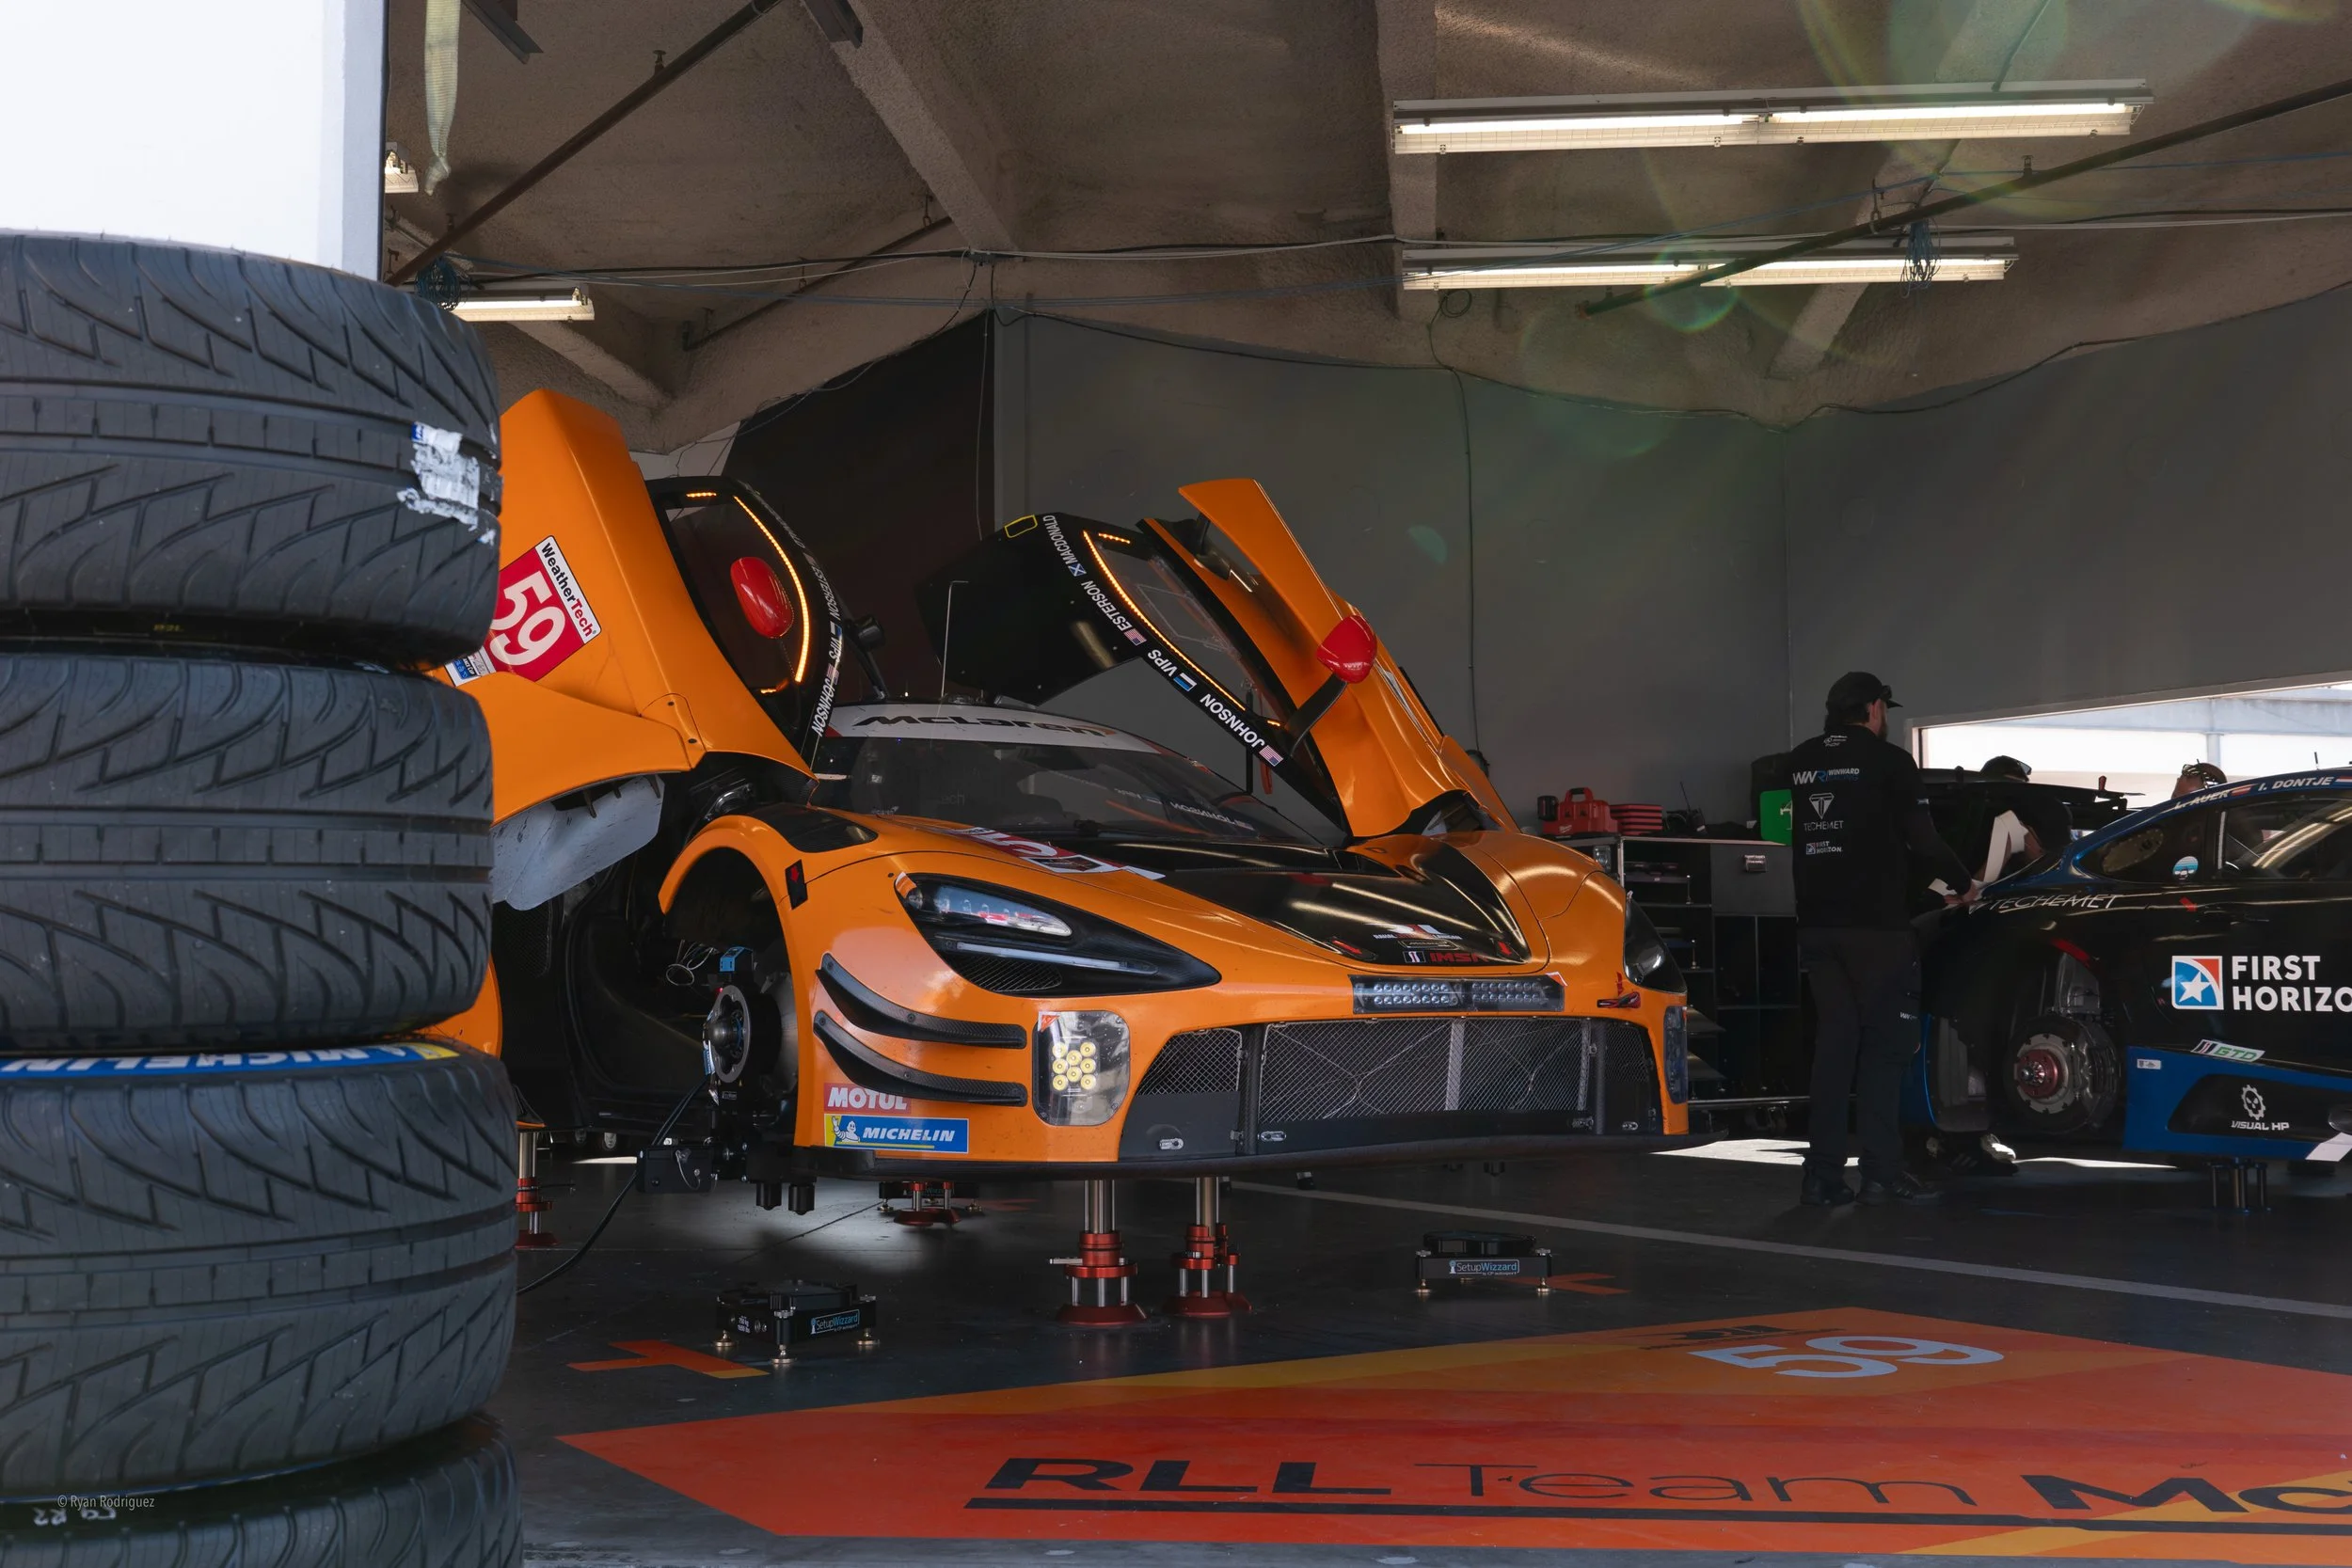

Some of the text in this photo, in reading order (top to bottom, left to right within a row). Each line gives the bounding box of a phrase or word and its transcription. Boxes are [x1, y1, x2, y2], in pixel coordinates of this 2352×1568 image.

[541, 542, 595, 638] WeatherTech
[489, 570, 565, 666] 59
[1042, 515, 1266, 747] MACDONALD ESTERSON VIPS JOHNSON
[811, 565, 843, 738] ESTERSON VIPS JOHNSON
[852, 715, 1107, 737] McLaren
[2271, 776, 2335, 791] DONTJE
[1803, 820, 1844, 832] TECHEMET
[1989, 894, 2119, 911] TECHEMET
[2231, 955, 2321, 981] FIRST
[2232, 986, 2352, 1013] HORIZO
[1, 1047, 369, 1072] MICHELIN
[2214, 1046, 2258, 1061] GTD
[827, 1086, 908, 1110] MOTUL
[862, 1127, 956, 1142] MICHELIN
[2231, 1120, 2290, 1132] VISUAL HP
[1456, 1261, 1518, 1273] SetupWizzard
[816, 1312, 858, 1331] SetupWizzard
[1687, 1335, 2005, 1379] 59
[984, 1456, 2352, 1514] RLL Team Mc
